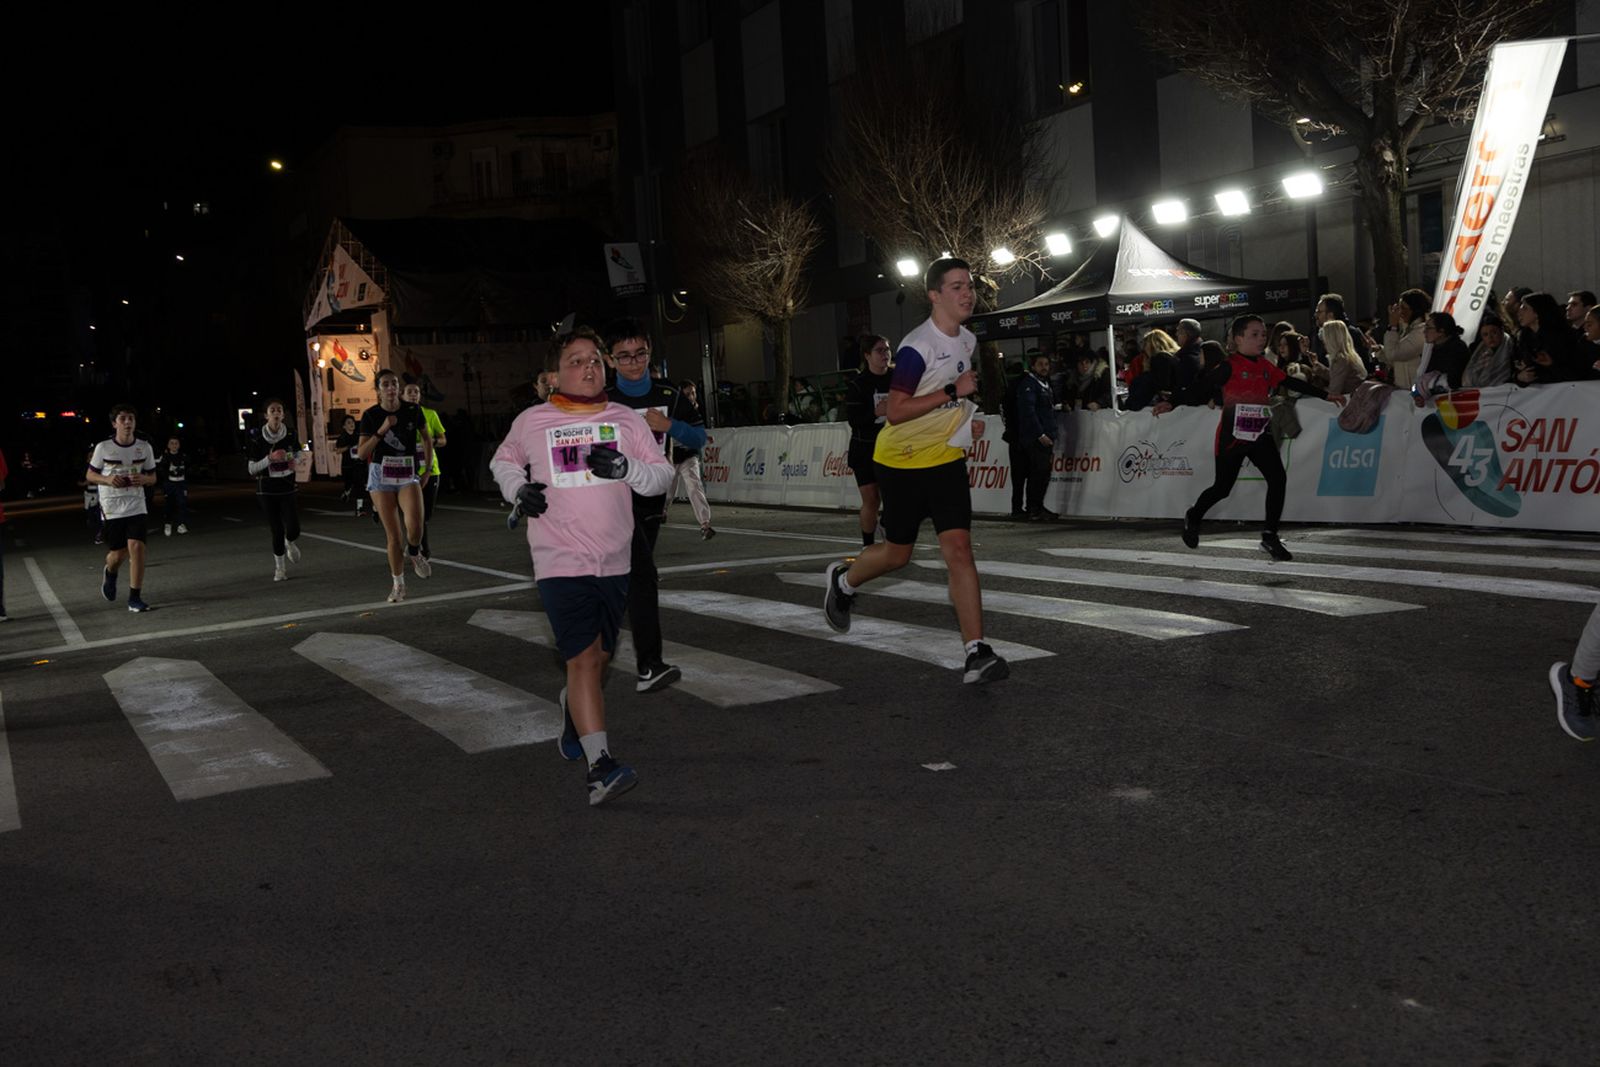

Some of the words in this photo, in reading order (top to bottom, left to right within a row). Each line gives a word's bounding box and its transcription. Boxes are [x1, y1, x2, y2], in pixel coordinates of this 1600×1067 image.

[1469, 252, 1498, 312] obras
[1491, 142, 1530, 247] maestras
[1501, 417, 1579, 453] SAN
[703, 446, 721, 463] SAN
[966, 440, 990, 462] AN
[1050, 452, 1101, 472] lderón
[1328, 446, 1375, 469] alsa
[1448, 434, 1494, 487] 43
[781, 459, 809, 480] aqualia
[967, 459, 1008, 489] NTÓN
[1496, 447, 1600, 494] ANTÓ
